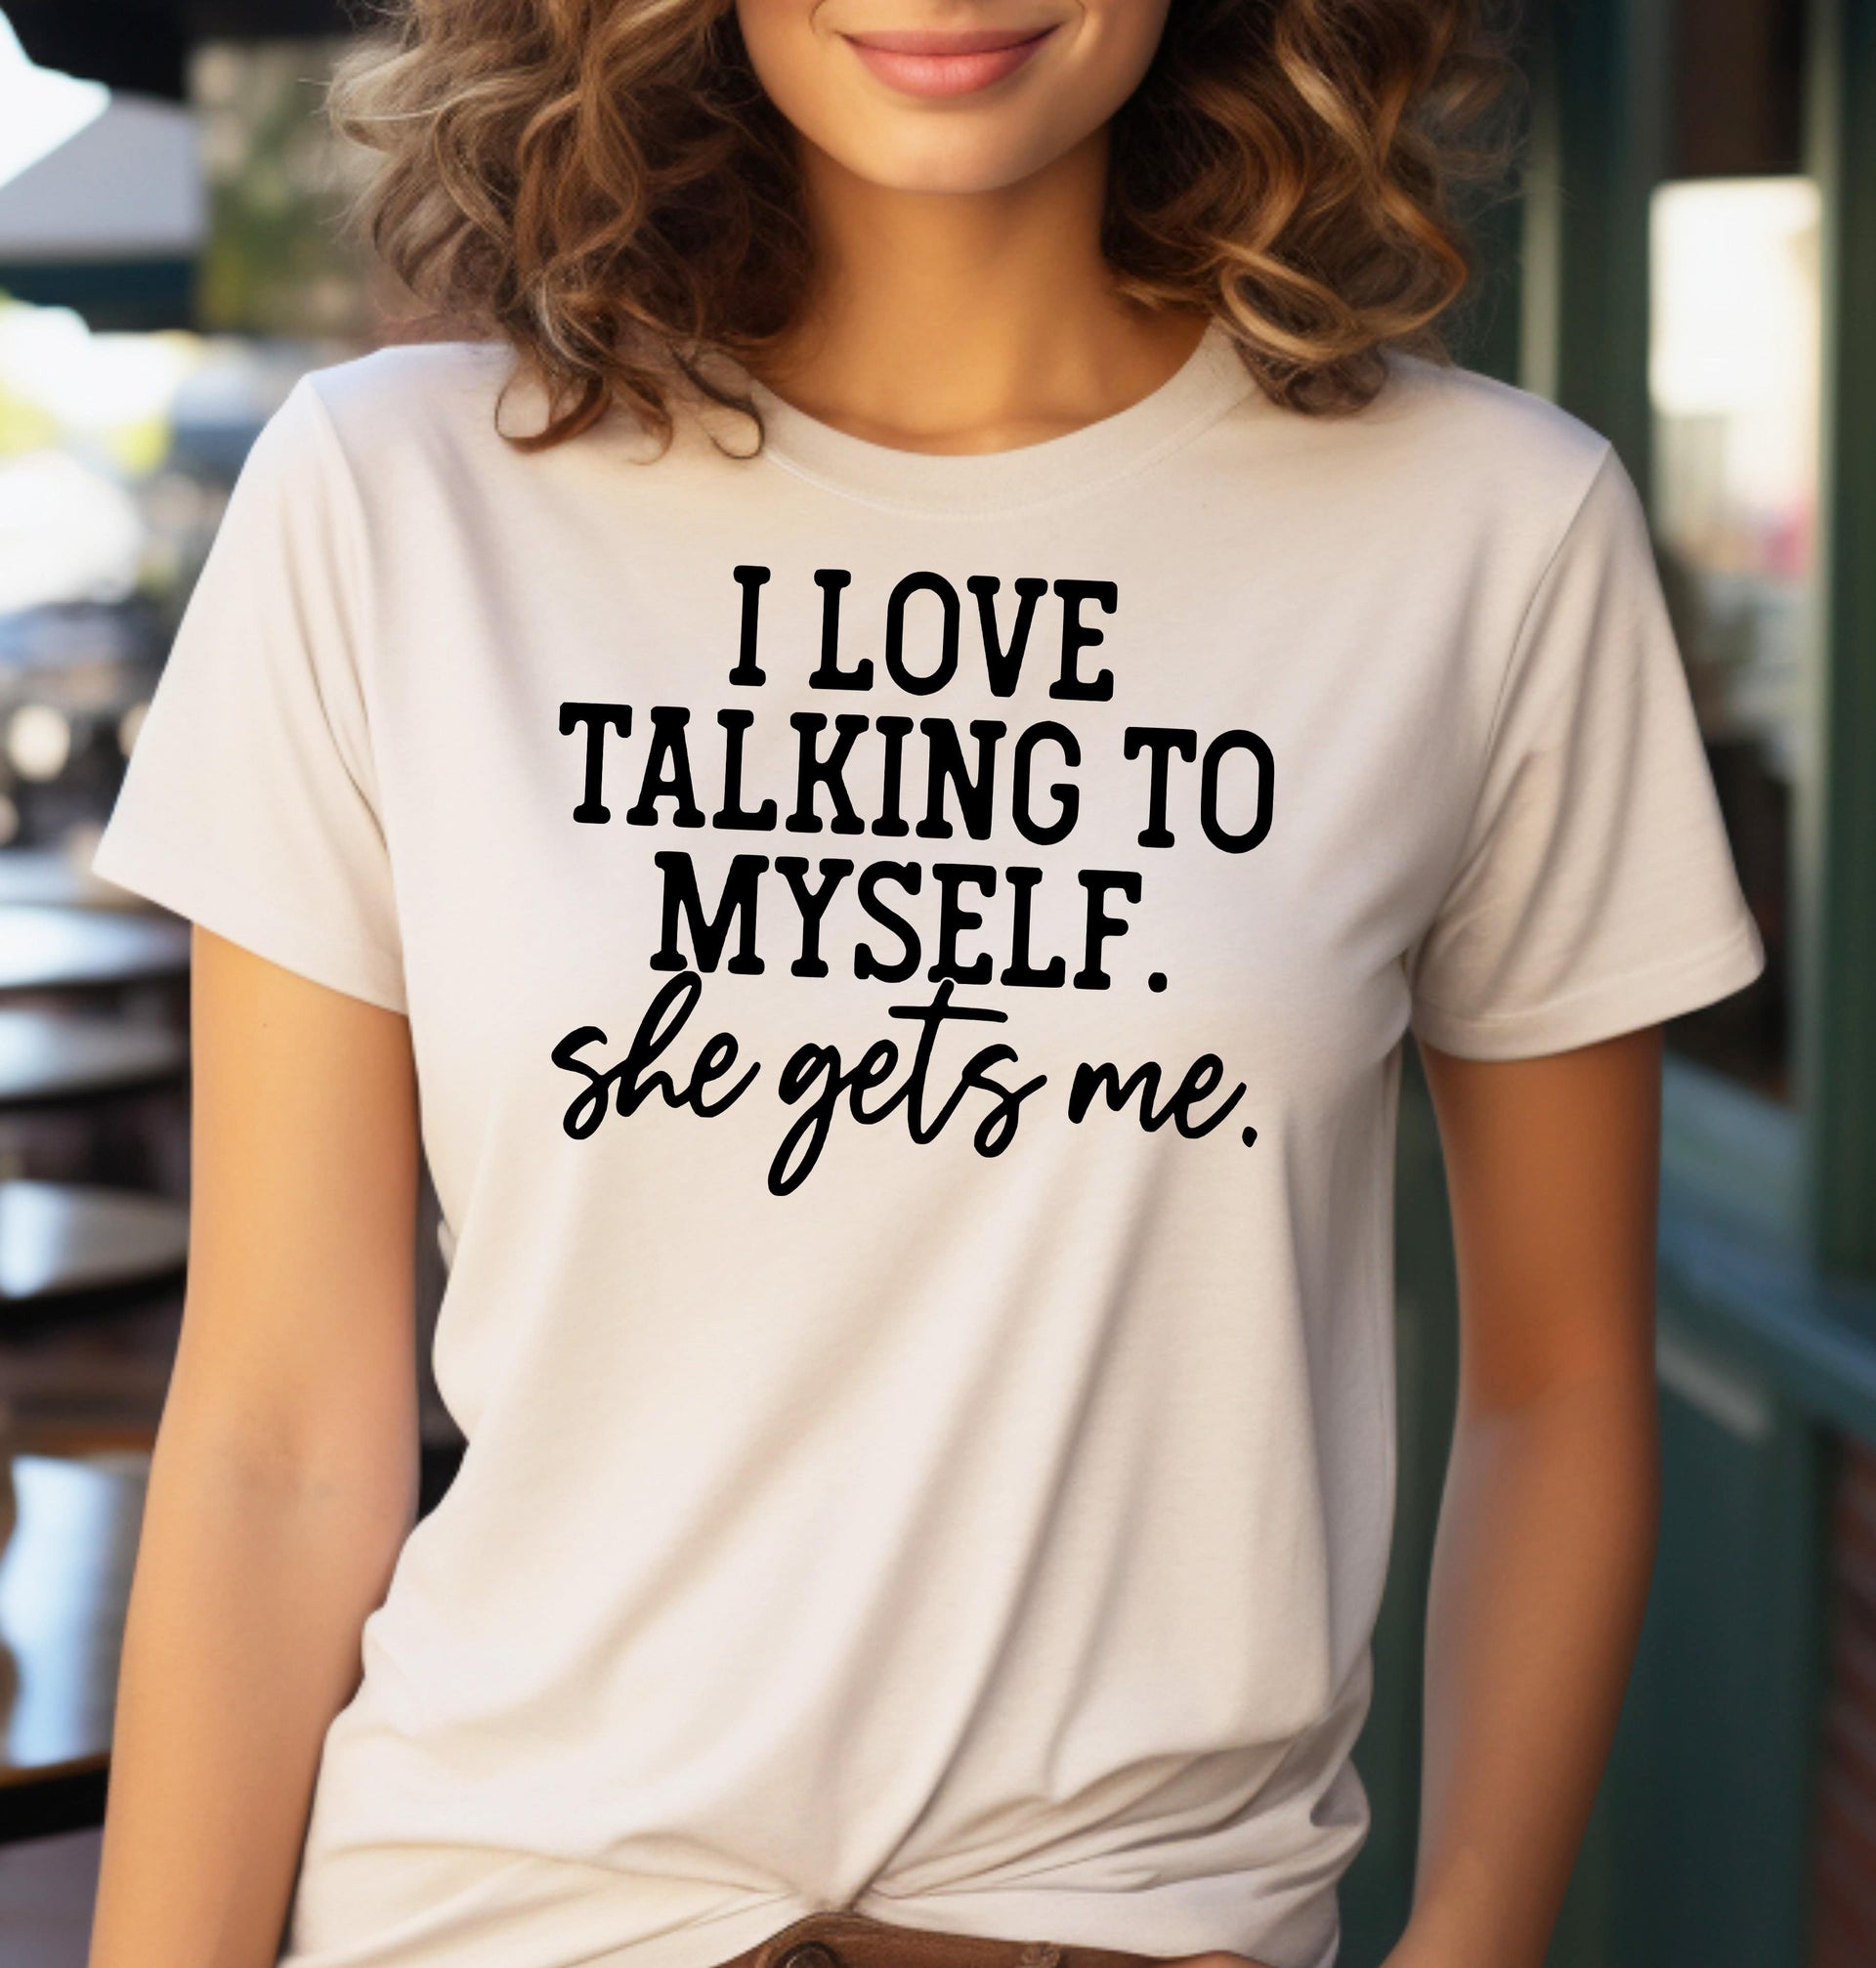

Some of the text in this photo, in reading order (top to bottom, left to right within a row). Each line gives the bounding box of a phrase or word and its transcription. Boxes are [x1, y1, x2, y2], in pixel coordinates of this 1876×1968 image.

[730, 565, 1118, 703] I LOVE
[558, 702, 1275, 854] TALKING TO
[650, 850, 1168, 993] MYSELF.
[552, 970, 1258, 1197] she gets me.
